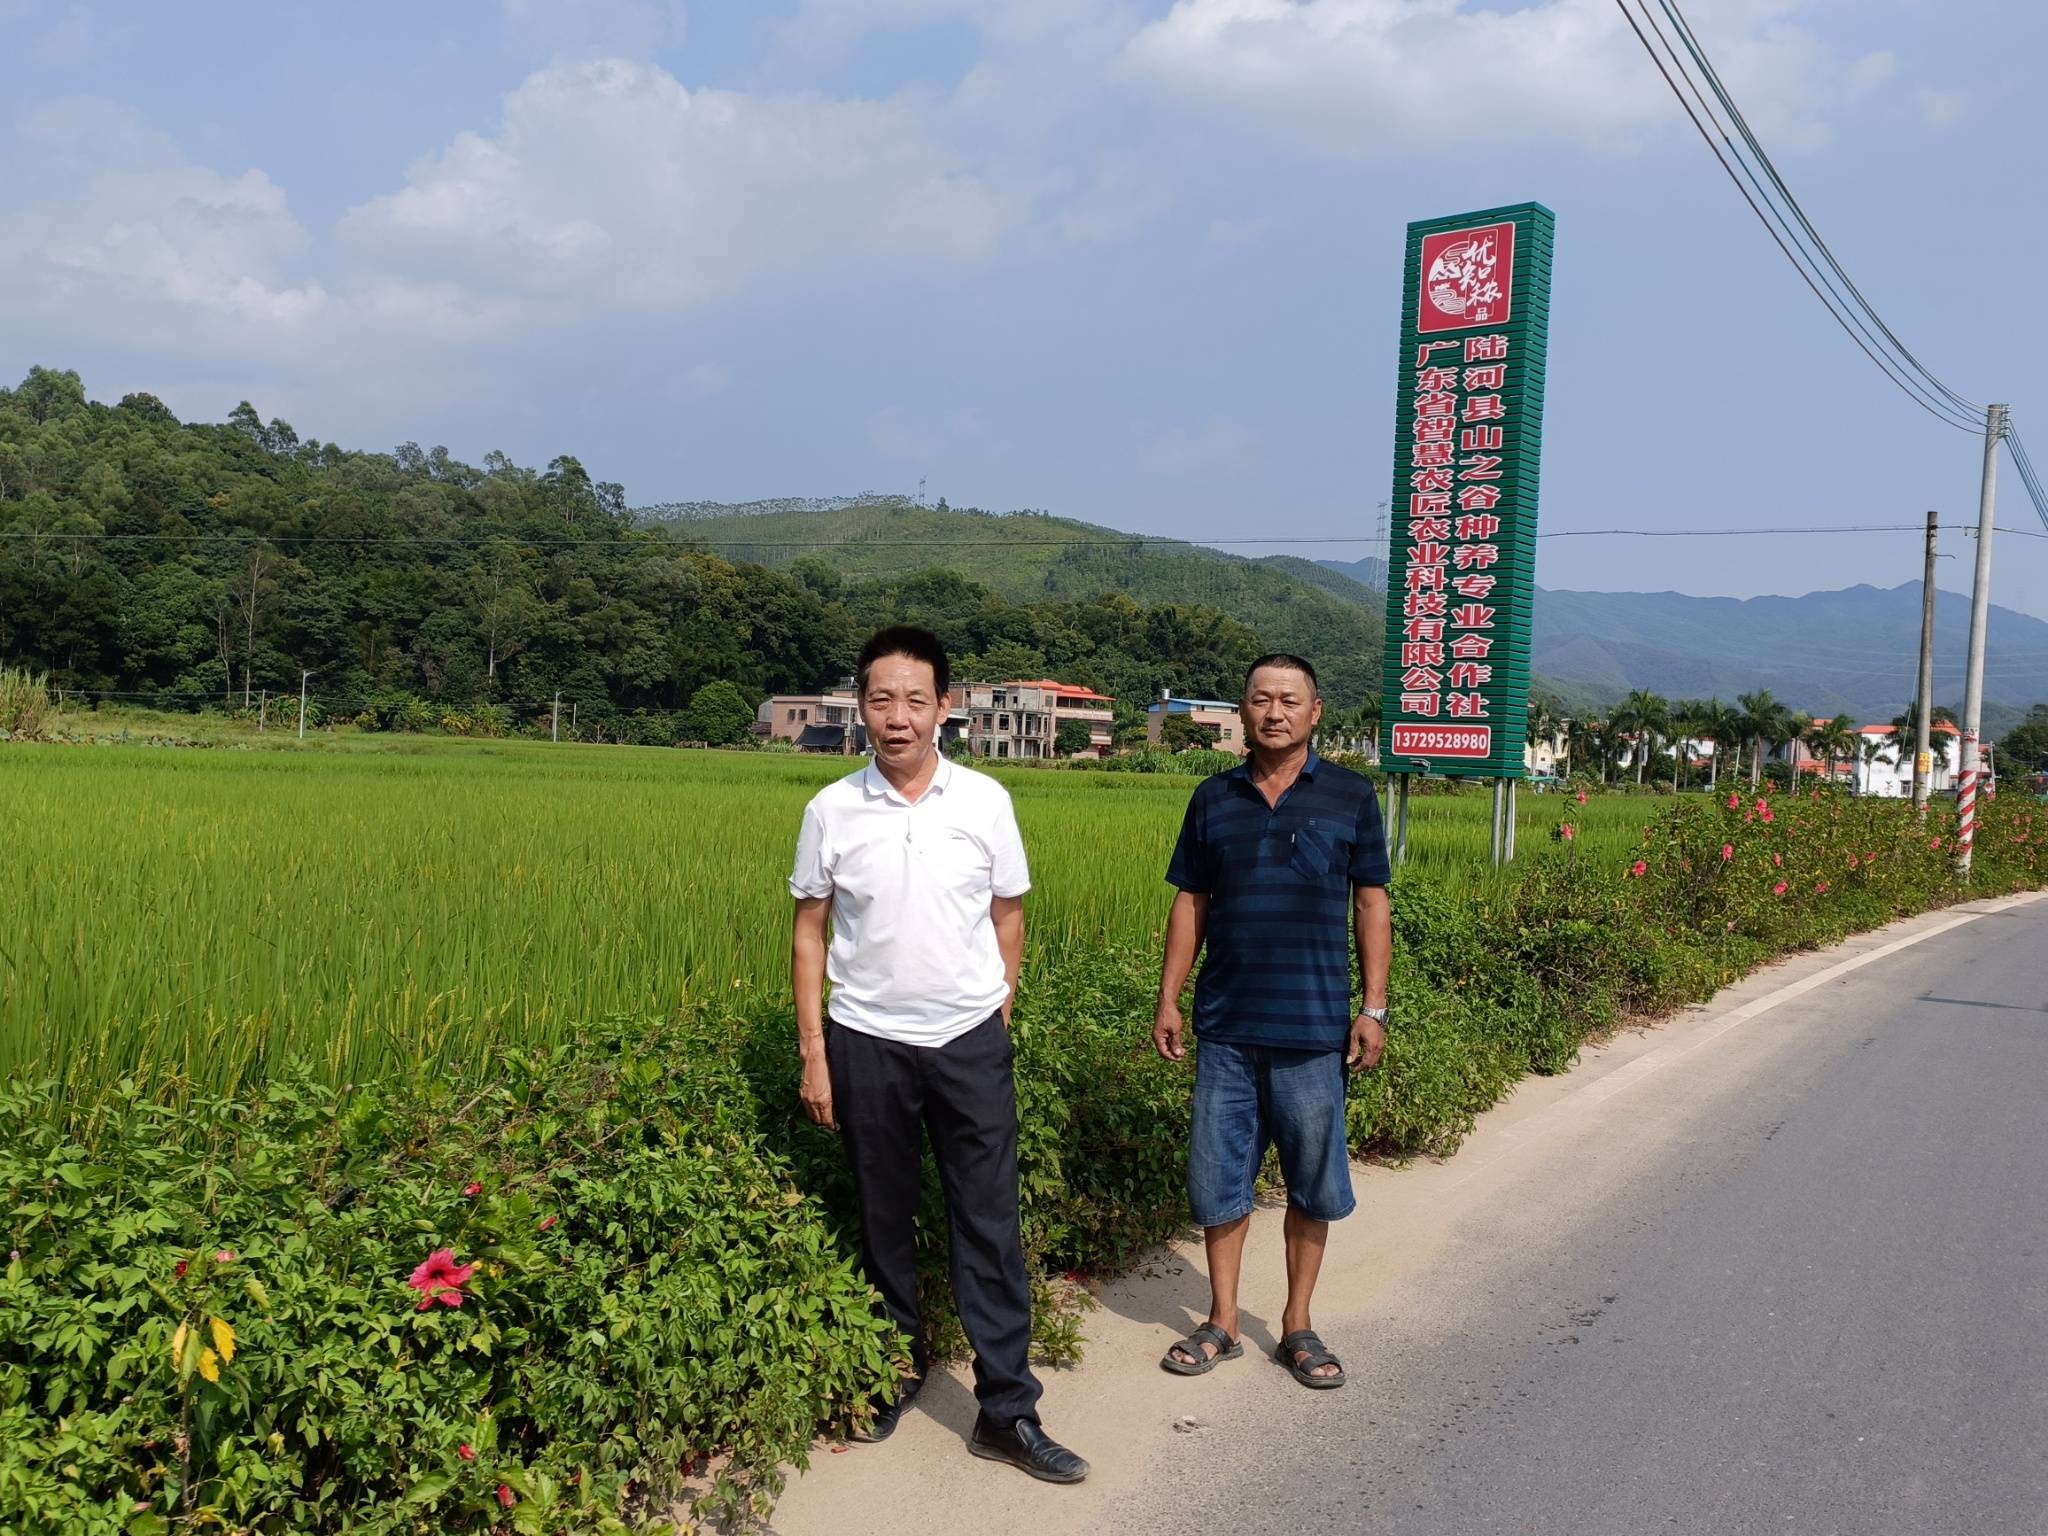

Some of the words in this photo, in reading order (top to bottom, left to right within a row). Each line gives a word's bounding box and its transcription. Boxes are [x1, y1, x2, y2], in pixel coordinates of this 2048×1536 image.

[1400, 341, 1460, 717] 广东省智慧农匠农业科技有限公司
[1446, 335, 1508, 718] 陆河县山之谷种养专业合作社
[1395, 731, 1488, 750] 13729528980
